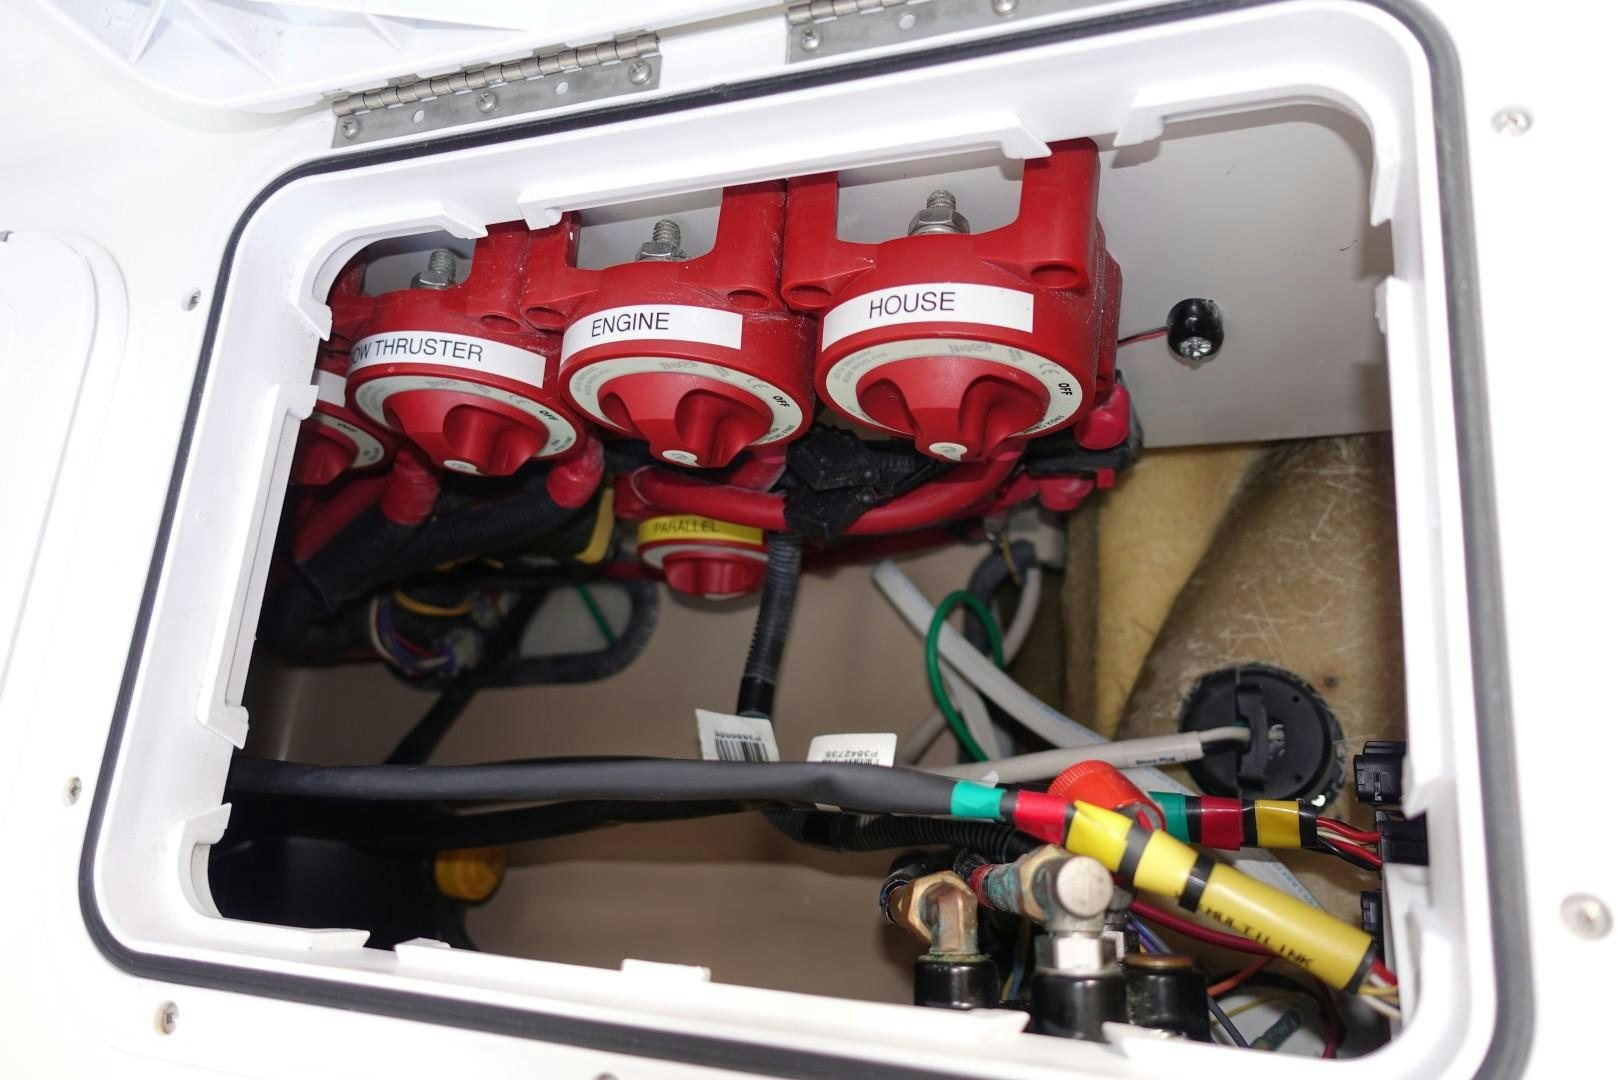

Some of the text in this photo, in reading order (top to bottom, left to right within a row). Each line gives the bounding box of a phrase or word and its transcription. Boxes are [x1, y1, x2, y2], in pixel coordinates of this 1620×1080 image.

[868, 291, 957, 319] HOUSE
[591, 311, 670, 338] ENGINE
[375, 337, 484, 362] THRUSTER
[1058, 382, 1073, 397] OFF
[772, 395, 791, 408] OFF
[538, 409, 560, 421] OFF
[653, 519, 720, 533] PARALLEL
